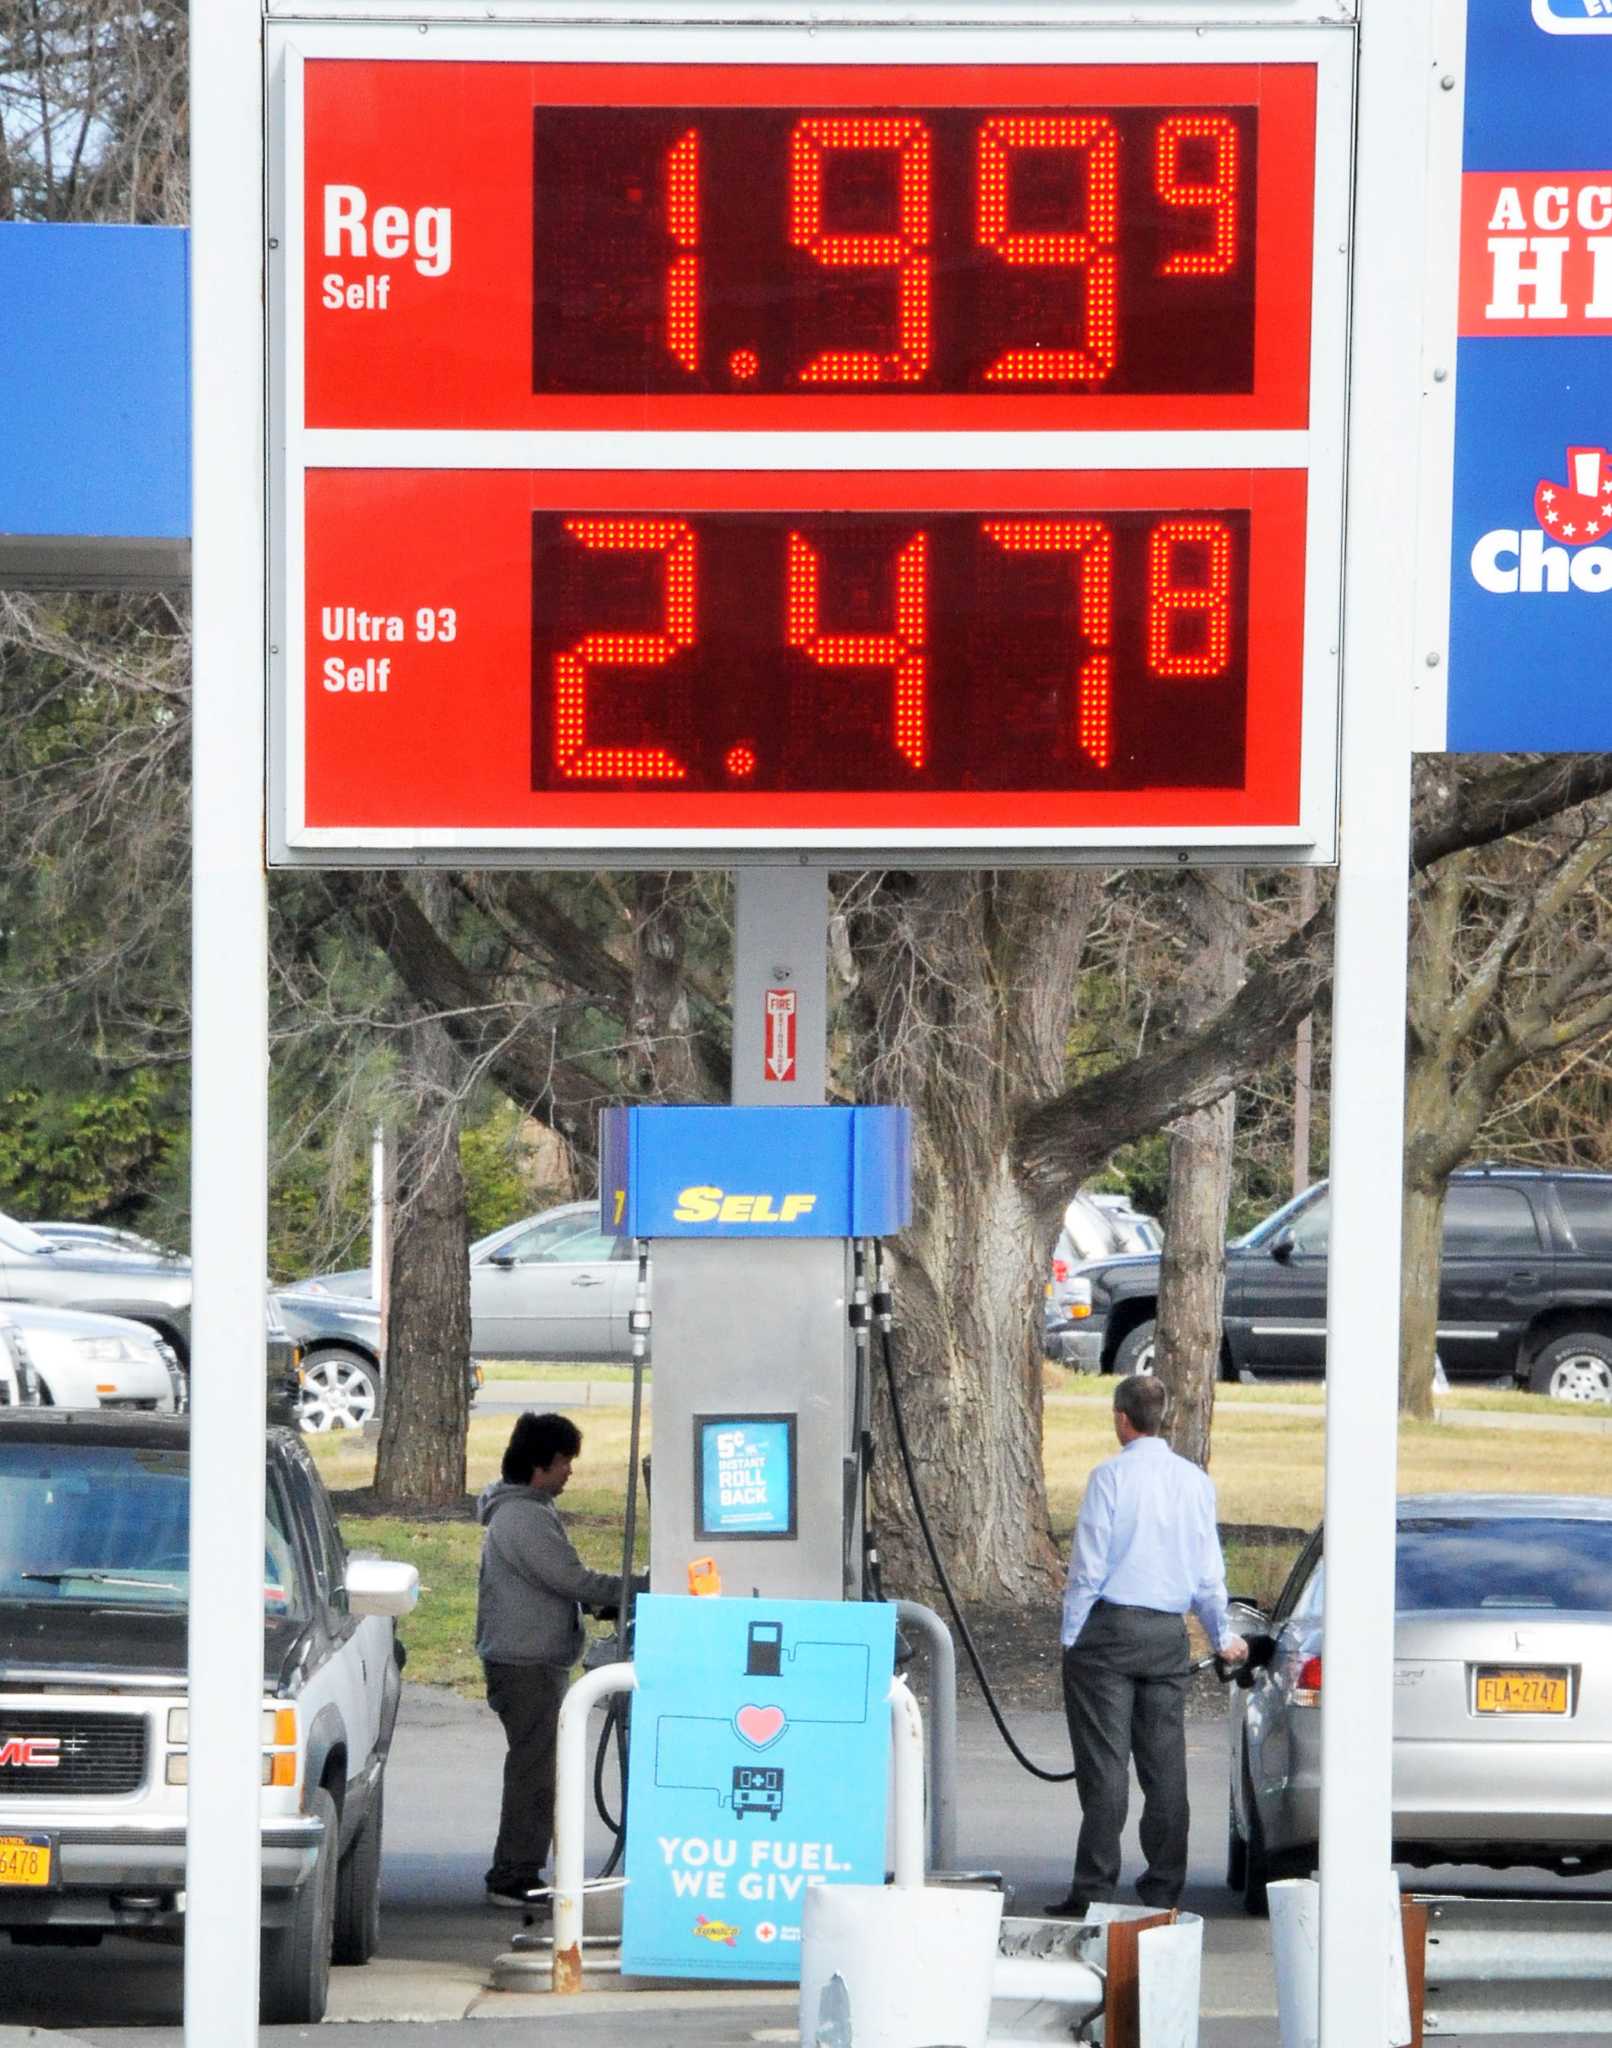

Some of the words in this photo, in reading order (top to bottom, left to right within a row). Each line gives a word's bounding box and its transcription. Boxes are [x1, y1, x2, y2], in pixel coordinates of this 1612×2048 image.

[1487, 186, 1612, 231] ACC
[322, 184, 453, 277] Reg
[321, 274, 390, 310] Self
[1471, 529, 1612, 594] Cho
[321, 607, 405, 642] Ultra
[415, 607, 457, 642] 93
[322, 657, 391, 693] Self
[770, 999, 792, 1011] FIRE
[719, 1468, 768, 1489] ROLL
[720, 1486, 769, 1507] BACK
[658, 1837, 738, 1868] YOU
[751, 1840, 853, 1871] FUEL.
[671, 1870, 727, 1899] WE
